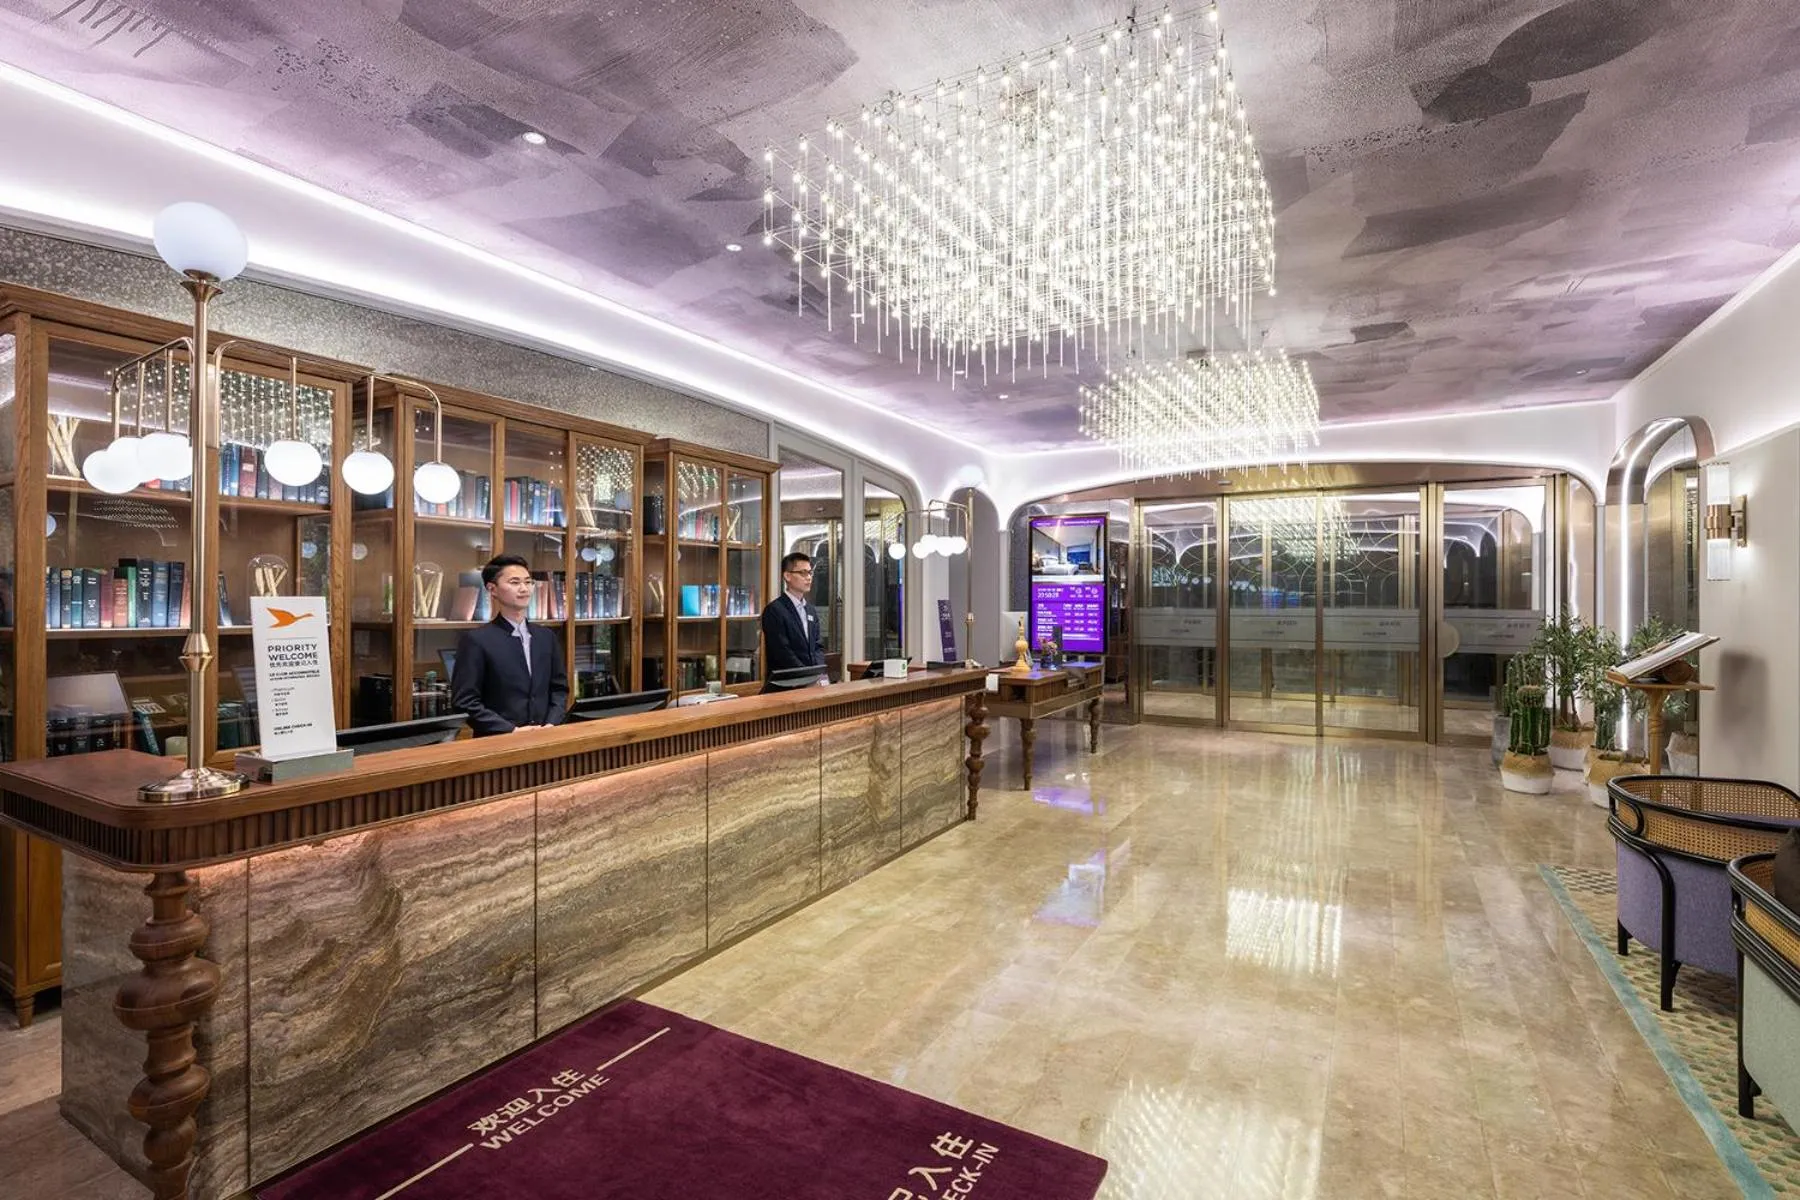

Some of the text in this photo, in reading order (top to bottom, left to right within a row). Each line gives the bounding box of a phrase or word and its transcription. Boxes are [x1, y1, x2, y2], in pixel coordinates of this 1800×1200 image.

[267, 644, 317, 652] PRIORITY
[268, 652, 318, 661] WELCOME
[467, 1069, 586, 1136] 欢迎入住
[480, 1073, 610, 1150] WELCOME
